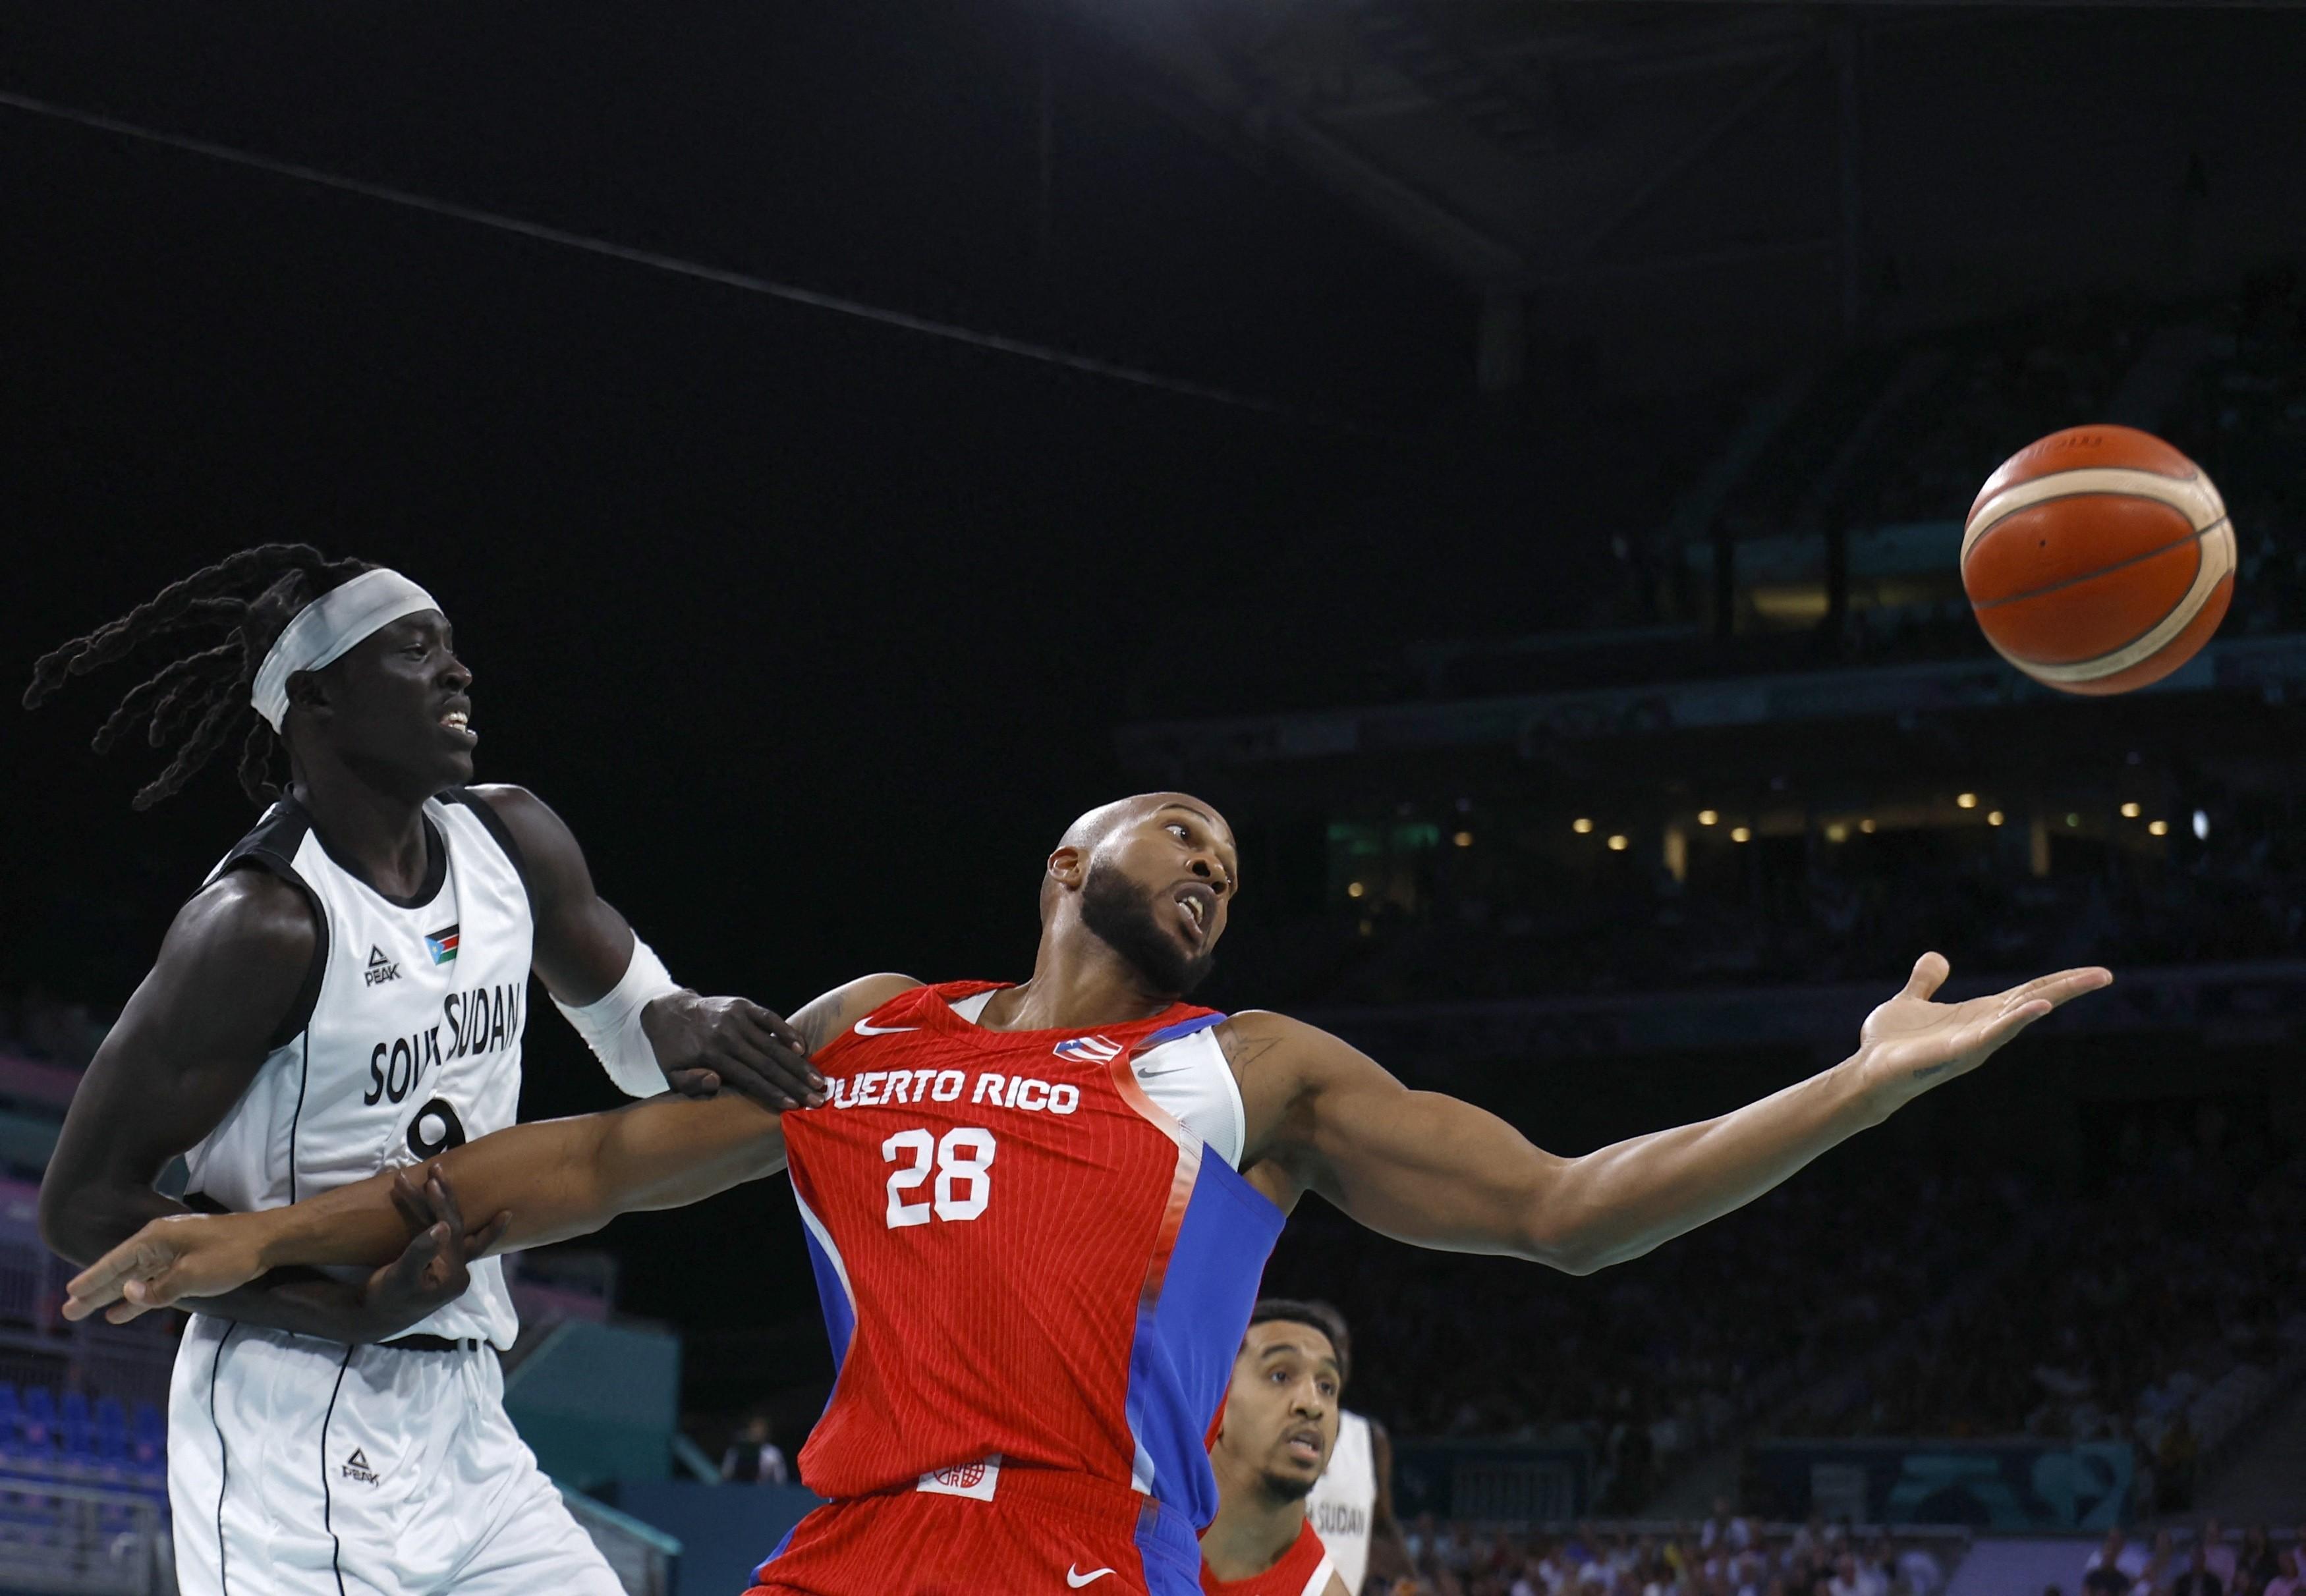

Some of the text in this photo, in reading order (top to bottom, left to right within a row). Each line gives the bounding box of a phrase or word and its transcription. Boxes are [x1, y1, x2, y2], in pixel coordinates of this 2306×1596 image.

[364, 964, 401, 986] PEAK
[444, 983, 520, 1060] SUDAN
[971, 1072, 1081, 1115] RICO
[407, 1098, 465, 1160] 9
[882, 1127, 996, 1229] 28
